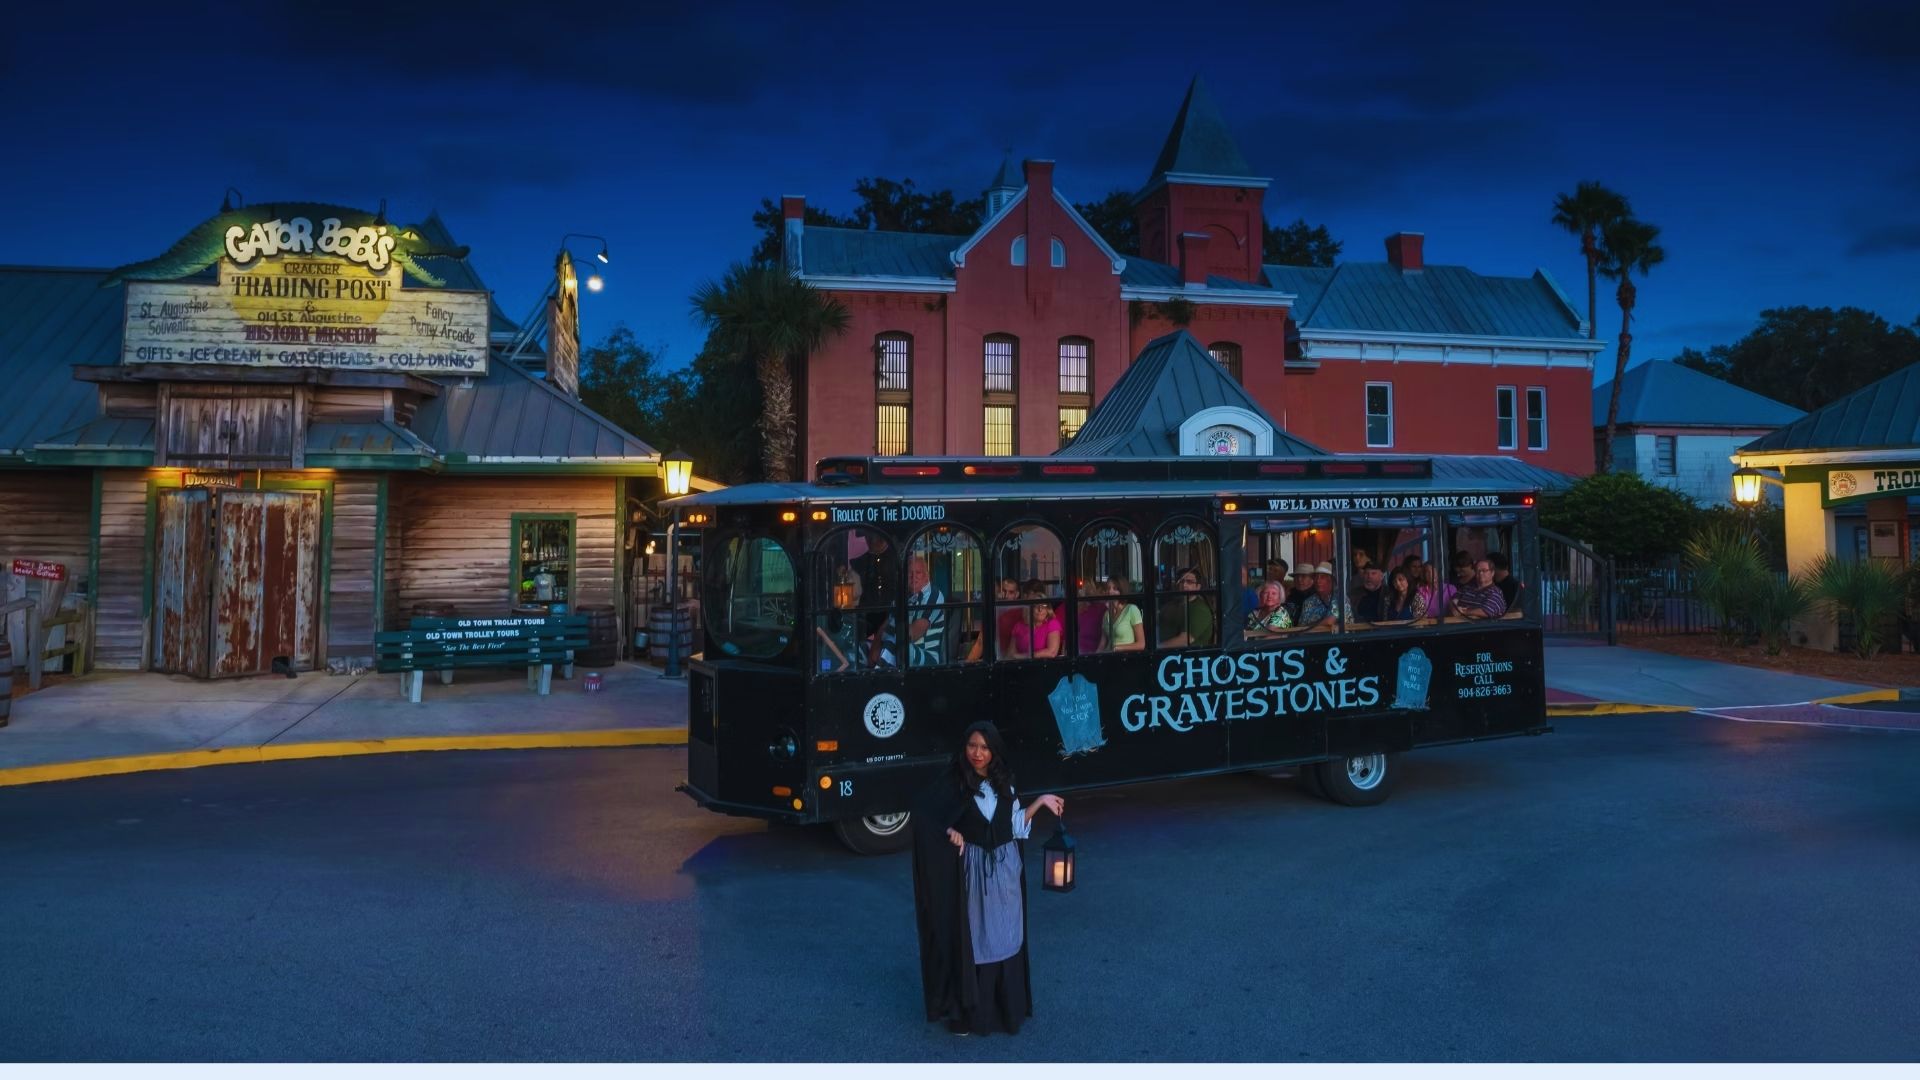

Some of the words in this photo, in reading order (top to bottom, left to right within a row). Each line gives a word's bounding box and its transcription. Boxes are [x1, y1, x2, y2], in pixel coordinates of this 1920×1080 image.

[225, 217, 314, 263] GATOR
[317, 217, 396, 271] BOB'S
[283, 262, 340, 275] CRACKER
[231, 276, 330, 299] TRADING
[335, 278, 391, 300] POST
[160, 296, 209, 320] Augustine
[257, 312, 277, 321] Old
[300, 311, 362, 323] Augustine
[425, 302, 454, 325] Fancy
[244, 325, 311, 341] HISTORY
[315, 326, 378, 344] MUSEUM
[410, 316, 438, 340] Penny
[440, 325, 475, 345] Arcade
[136, 347, 173, 361] GIFTS
[189, 350, 210, 361] ICE
[213, 350, 261, 362] CREAM
[389, 353, 425, 367] COLD
[428, 354, 475, 369] DRINKS
[1269, 499, 1307, 510] WE'LL
[1311, 499, 1350, 510] DRIVE
[1354, 499, 1378, 509] YOU
[1382, 498, 1399, 508] TO
[1402, 498, 1418, 507] AN
[1422, 496, 1459, 507] EARLY
[1462, 495, 1499, 506] GRAVE
[901, 505, 945, 520] DOOMED
[442, 632, 463, 640] TOWN
[465, 631, 495, 639] TROLLEY
[1476, 652, 1492, 662] FOR
[1157, 649, 1305, 692] GHOSTS
[1325, 647, 1348, 675] &
[1474, 675, 1494, 685] CALL
[1120, 676, 1379, 732] GRAVESTONES
[840, 780, 853, 796] 18
